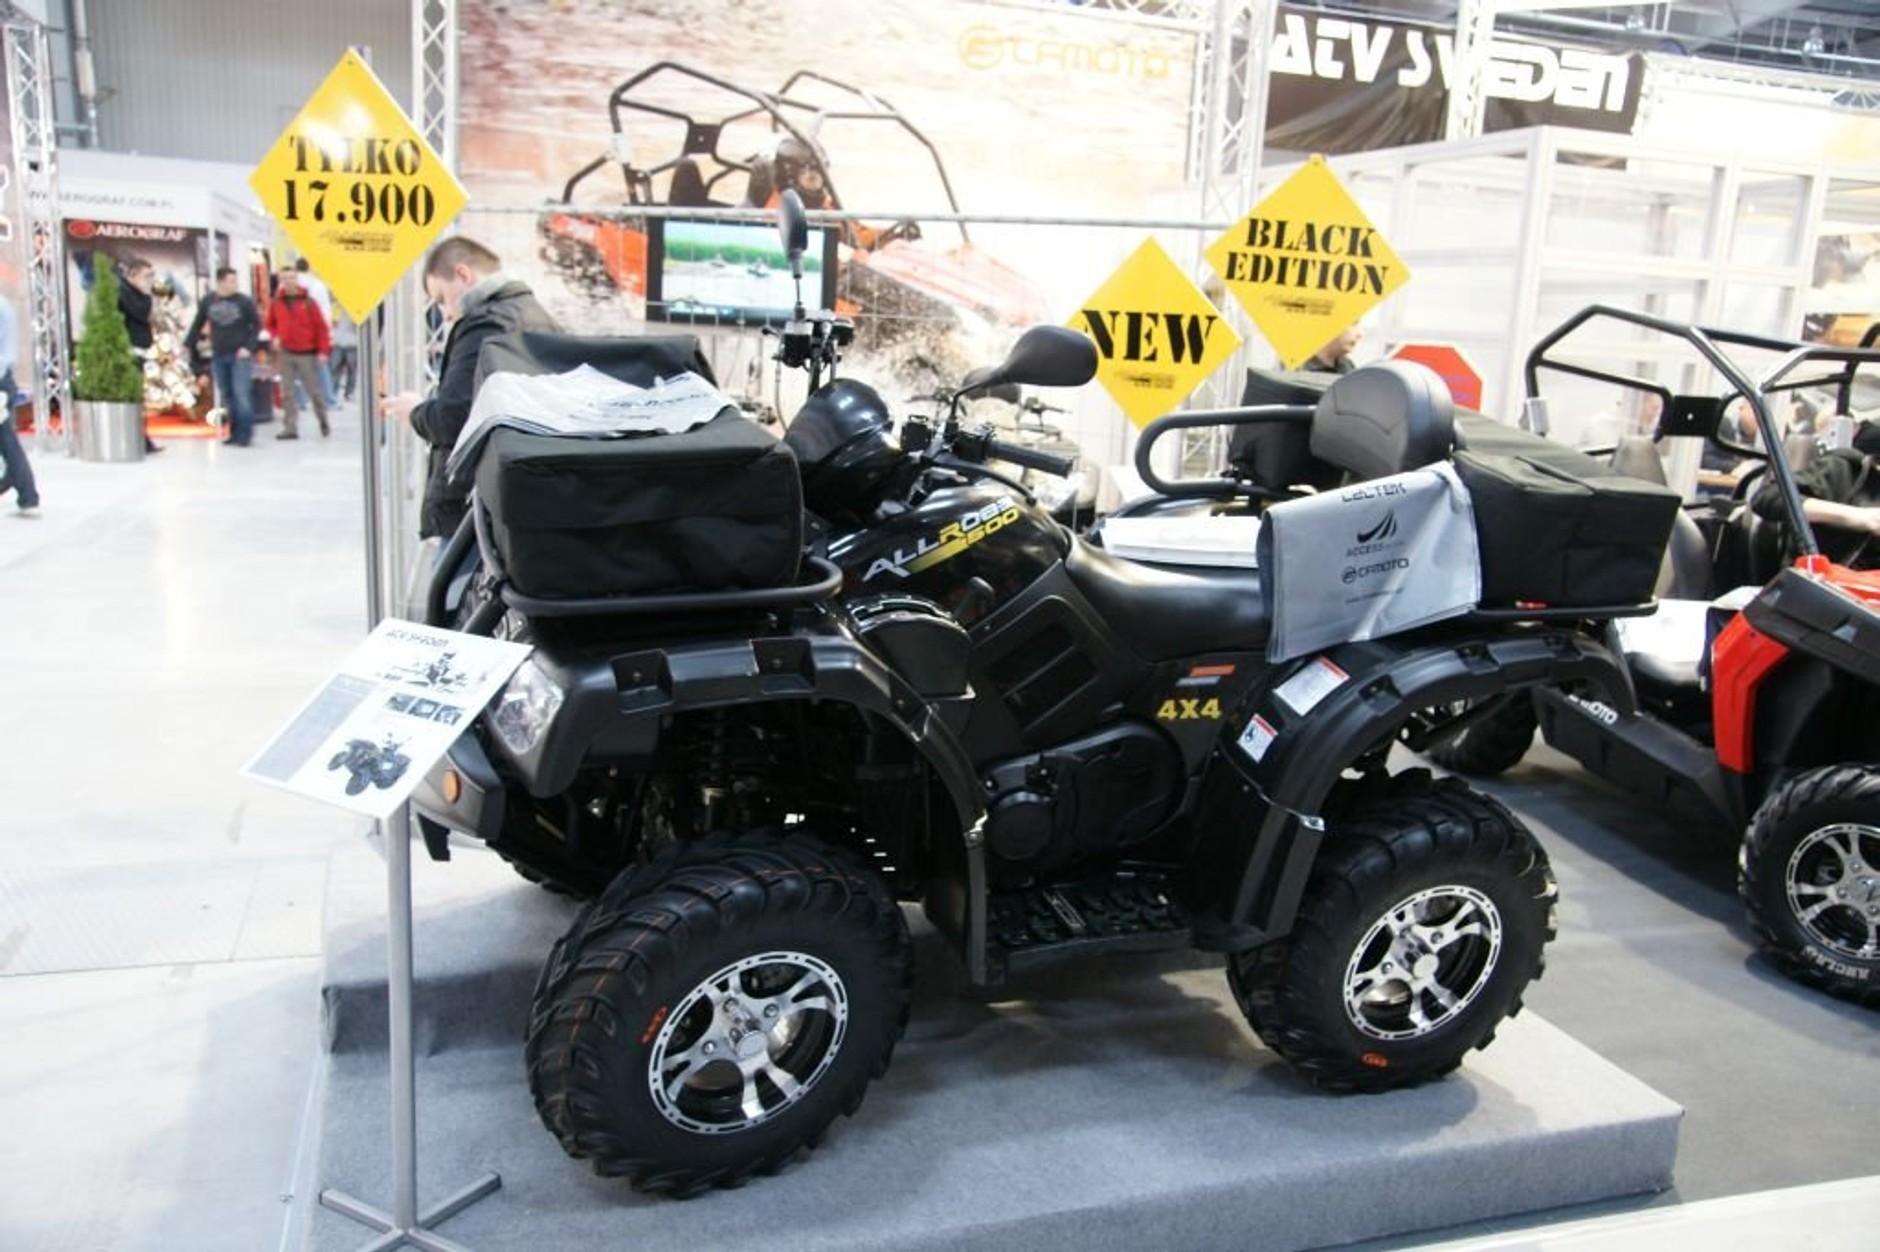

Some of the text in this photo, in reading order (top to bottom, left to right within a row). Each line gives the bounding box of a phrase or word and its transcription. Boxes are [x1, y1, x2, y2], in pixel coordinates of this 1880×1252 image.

[289, 135, 421, 176] TYLKO
[284, 179, 435, 227] 17.900
[95, 223, 188, 242] AEROGRAF
[1246, 218, 1376, 258] BLACK
[1225, 251, 1389, 296] EDITION
[1082, 309, 1218, 365] NEW
[966, 507, 1020, 546] 500
